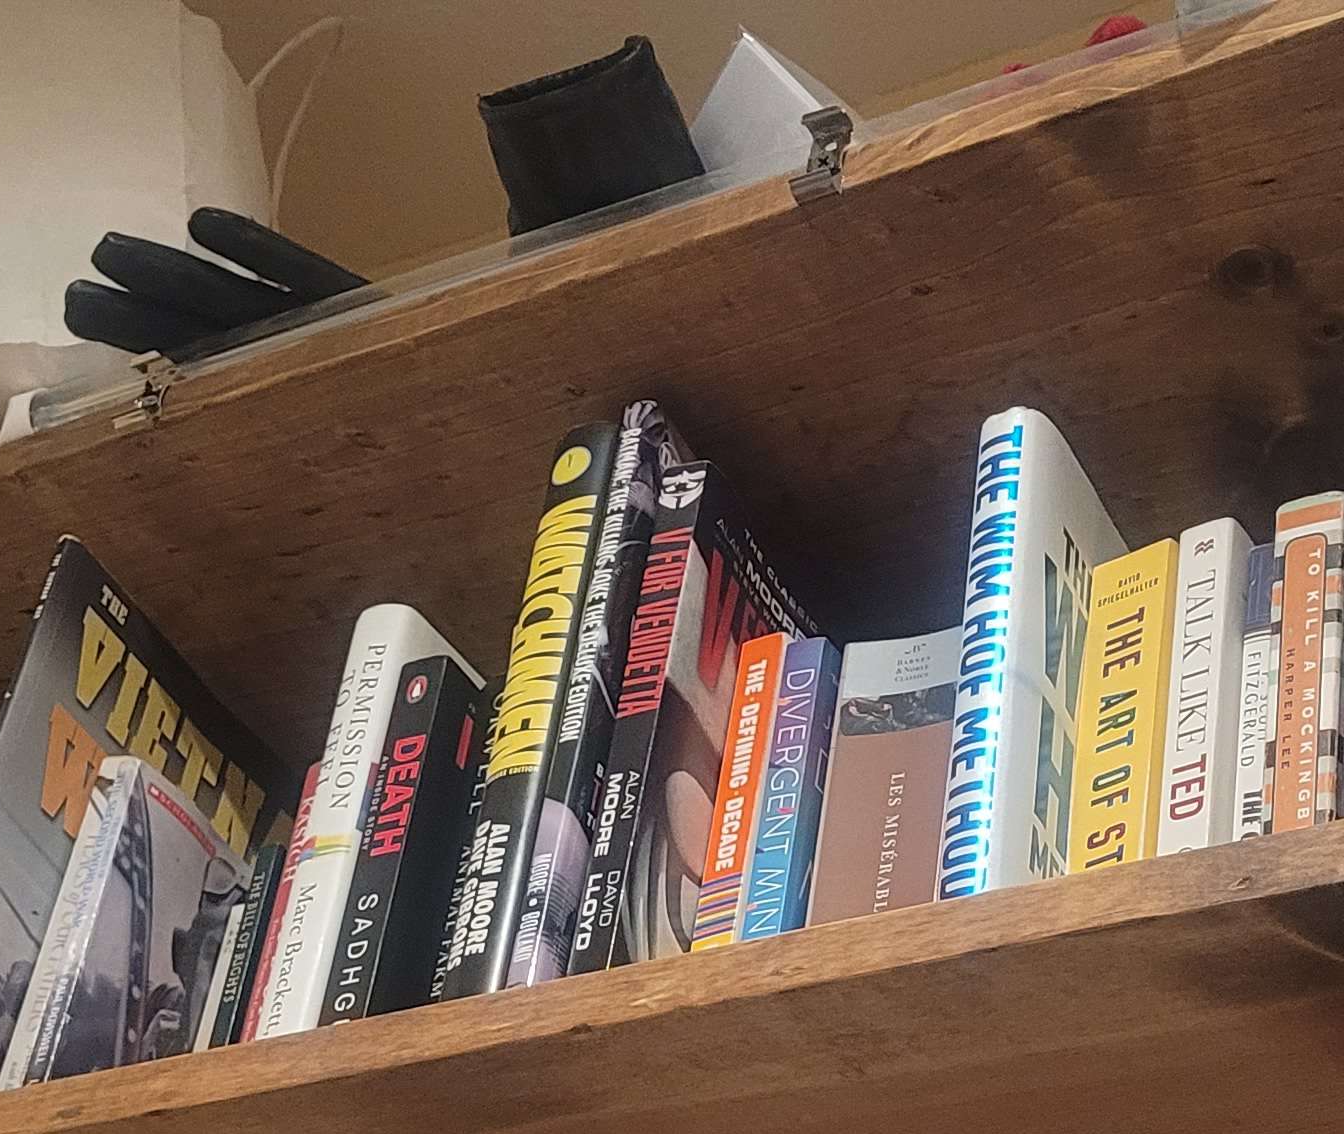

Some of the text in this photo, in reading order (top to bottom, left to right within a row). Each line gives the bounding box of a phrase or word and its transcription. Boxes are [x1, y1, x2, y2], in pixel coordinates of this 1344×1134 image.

[100, 584, 130, 626] THE
[958, 424, 1024, 697] THE WIM HOF
[1096, 577, 1159, 609] SPIEGELHALTER
[1118, 572, 1141, 589] DAVID
[1302, 548, 1321, 672] TO KILL A
[489, 493, 598, 778] WATCHMEN
[559, 486, 630, 744] THE KILLING JOKE DELUXE EDITION
[615, 526, 694, 719] V FOR VENDETTA
[328, 643, 387, 811] PERMISSION
[1090, 606, 1146, 808] THE ART OF
[1170, 568, 1216, 821] TALK LIKE TED
[1240, 651, 1262, 768] FITZGERALD
[1281, 648, 1296, 770] HARPER LEE
[360, 773, 386, 852] INSIDE STORY
[370, 733, 427, 858] DEATH
[620, 770, 640, 820] ALAN
[715, 658, 768, 871] THE DEFINING DECADE
[760, 668, 816, 855] DIVERGENT
[887, 772, 906, 807] LES
[594, 773, 623, 858] MOORE
[240, 901, 259, 934] BILL
[247, 872, 265, 901] THE
[286, 882, 318, 939] Marc
[446, 873, 480, 974] GIBBONS
[464, 822, 513, 956] ALAN MOORE
[513, 853, 553, 964] MOORE BOLLAND
[576, 873, 603, 951] LLOYD
[599, 870, 621, 928] DAVID
[223, 950, 246, 1003] RIGHTS
[262, 938, 304, 1036] Brackett,
